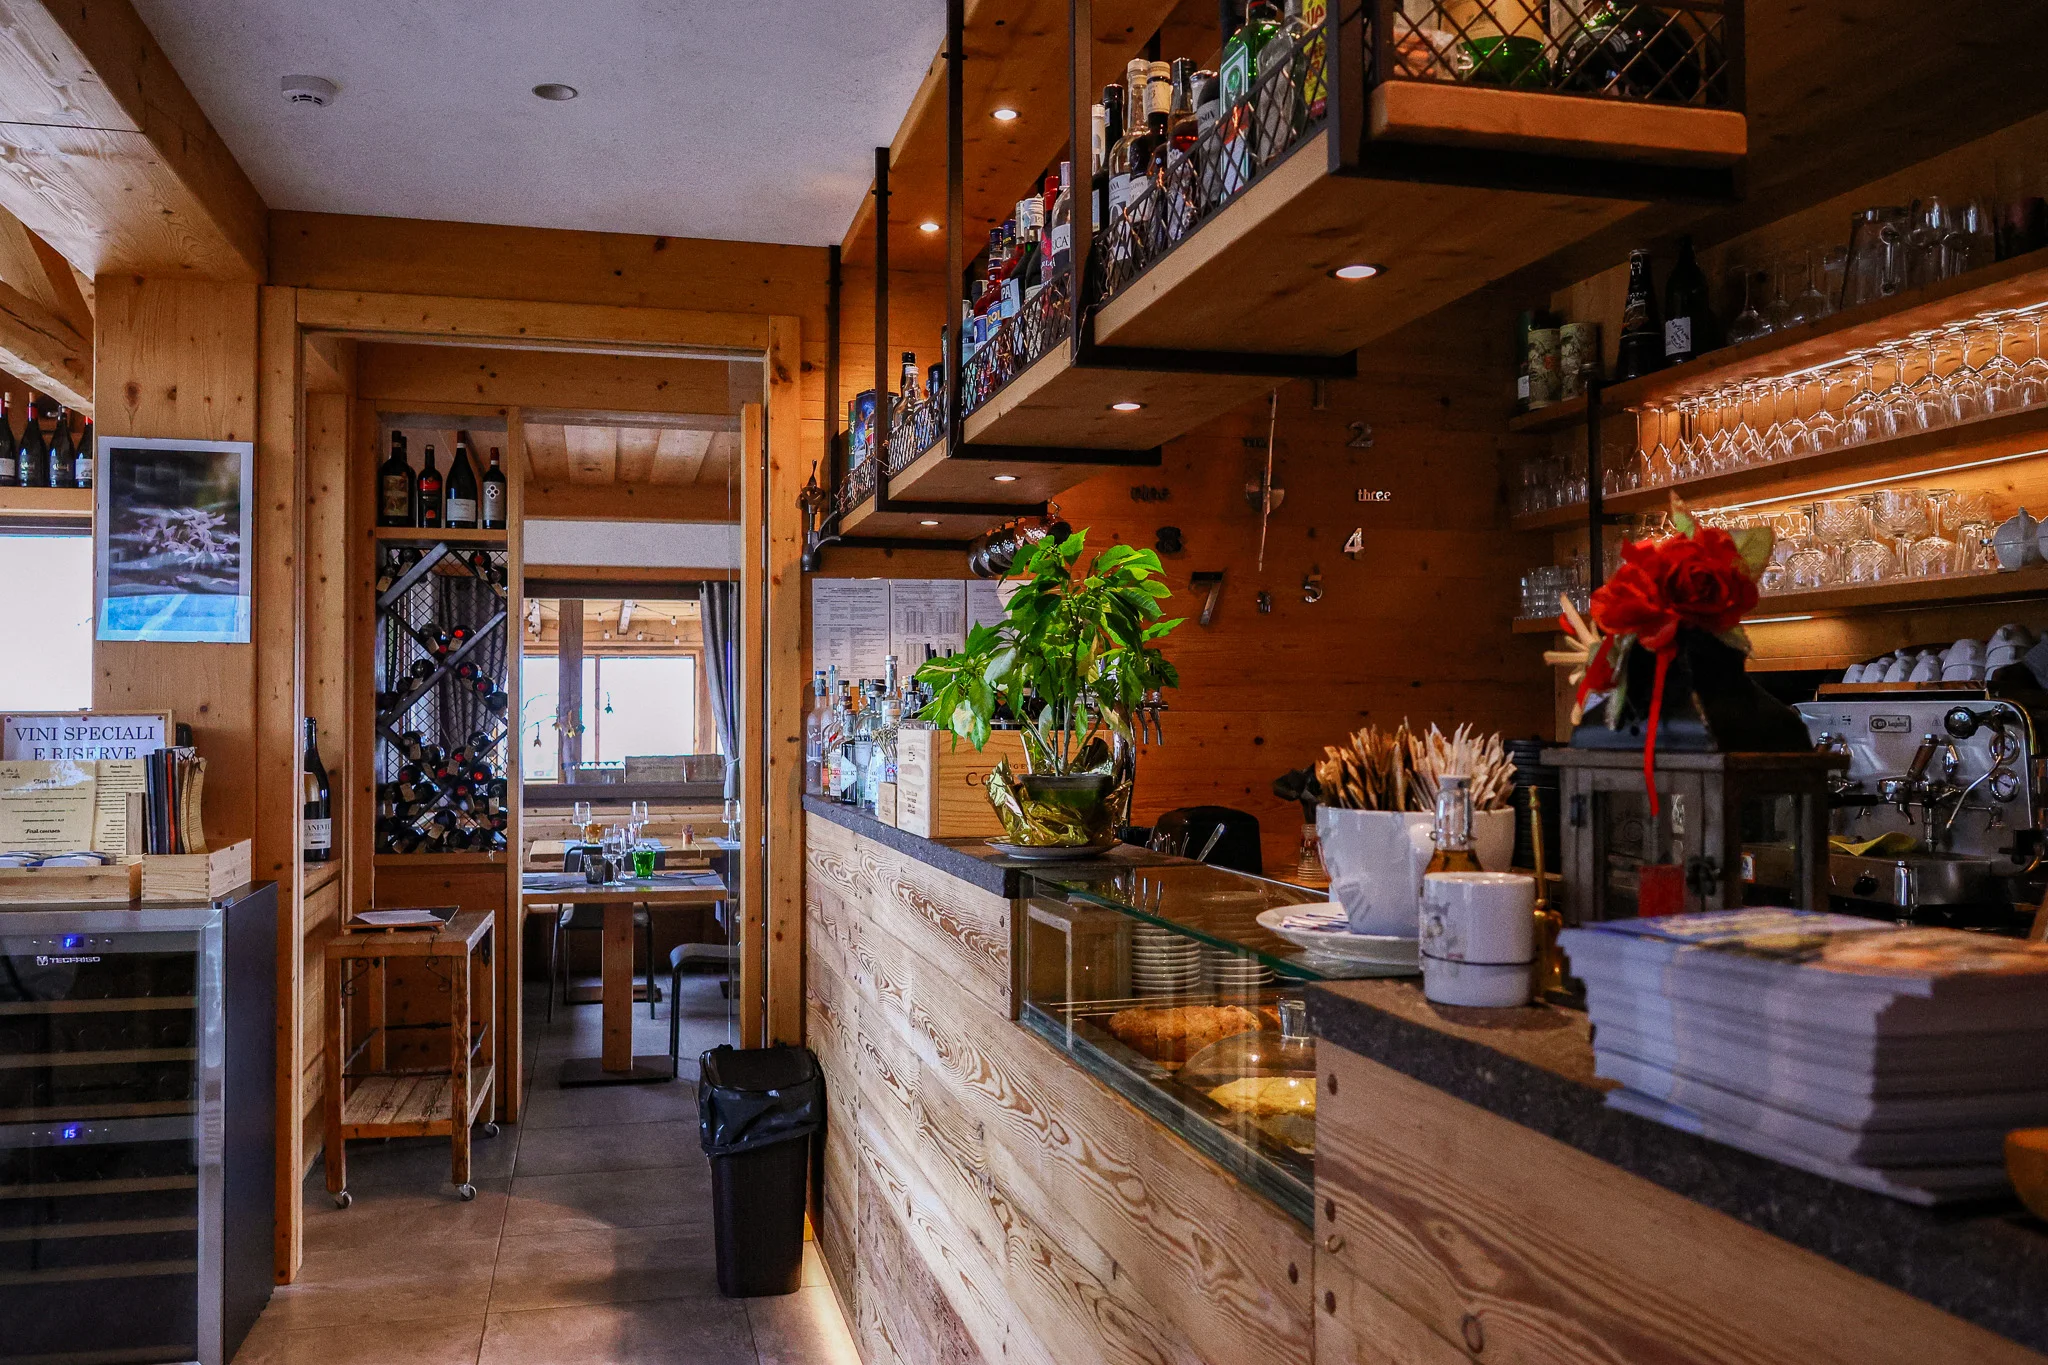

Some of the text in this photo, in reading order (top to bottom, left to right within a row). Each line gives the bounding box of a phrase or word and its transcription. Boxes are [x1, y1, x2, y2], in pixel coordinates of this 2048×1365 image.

[1347, 421, 1374, 448] 2
[1357, 488, 1391, 502] three
[1343, 527, 1364, 553] 4
[1304, 573, 1323, 603] 5
[1190, 568, 1227, 625] 7
[14, 725, 155, 741] VINI SPECIALI
[33, 746, 137, 760] E RISERVE
[49, 956, 101, 964] TECFRIGO
[63, 1129, 76, 1139] 15
